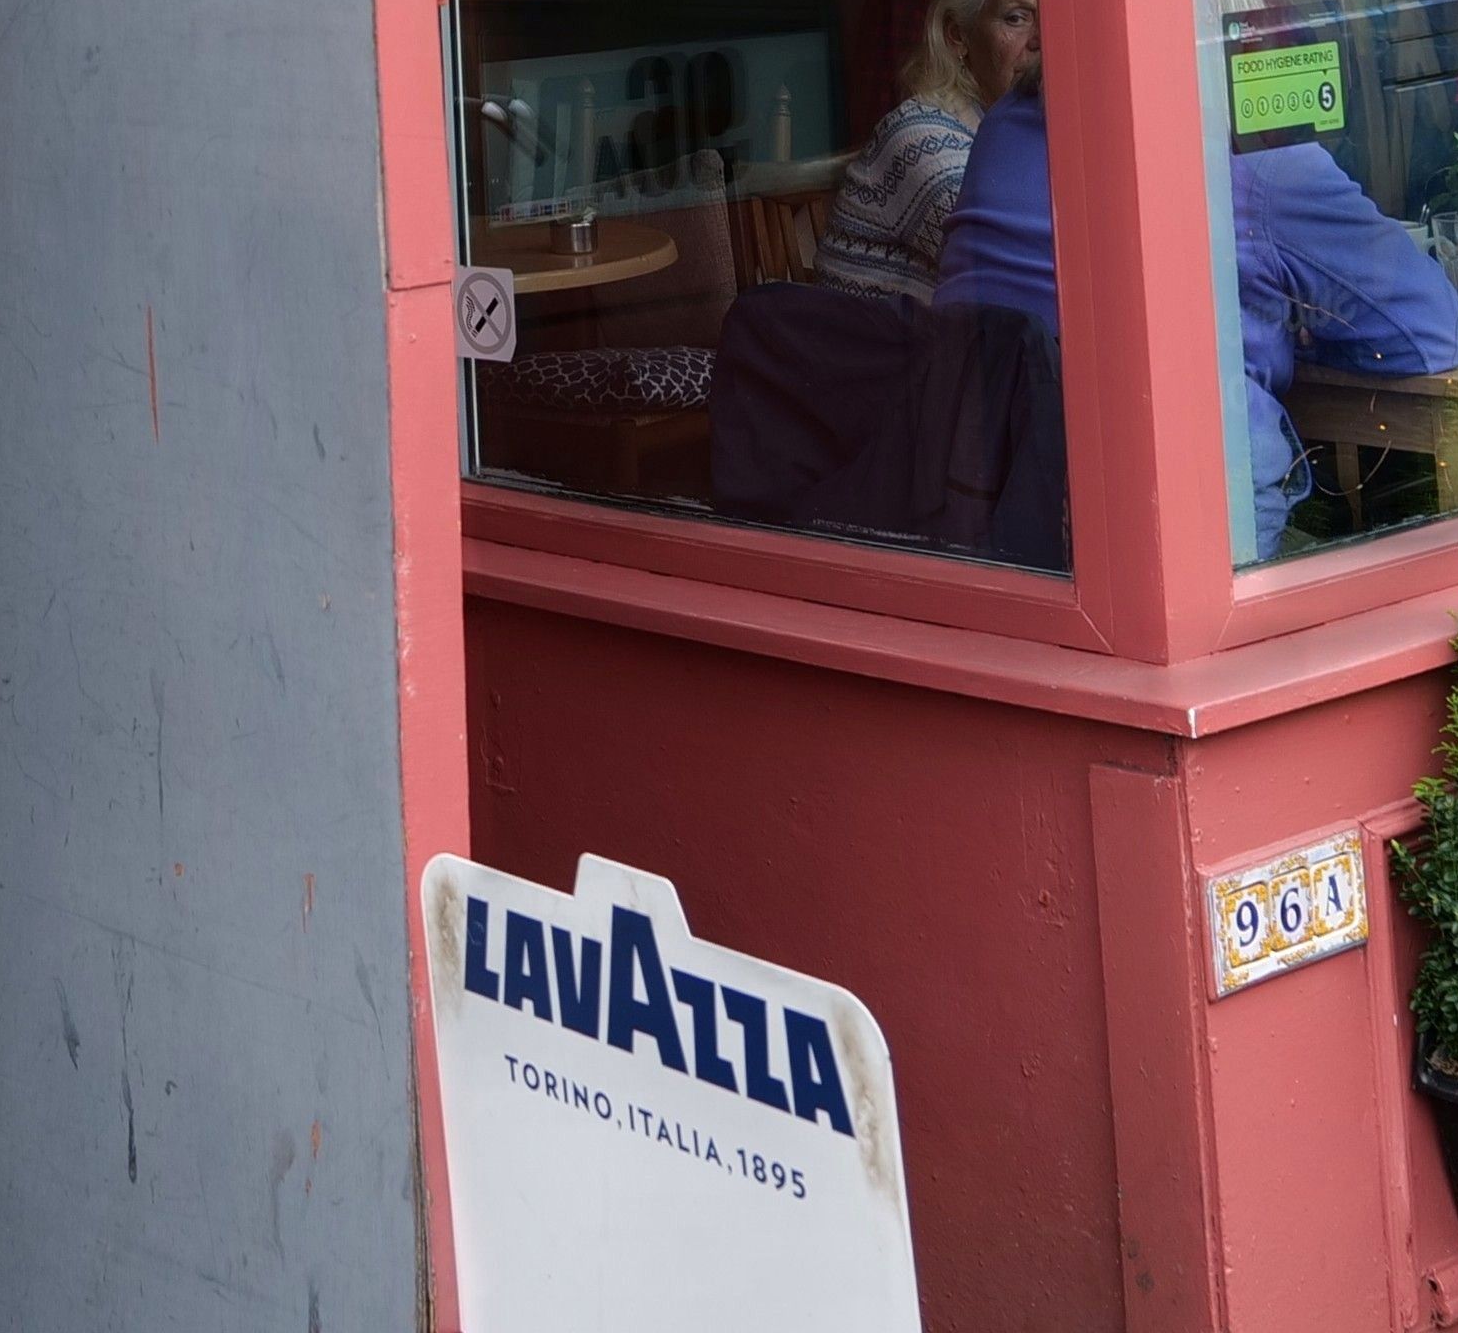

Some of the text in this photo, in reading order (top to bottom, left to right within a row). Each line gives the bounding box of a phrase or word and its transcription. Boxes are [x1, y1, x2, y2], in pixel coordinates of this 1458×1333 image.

[1237, 50, 1333, 75] FOOD HYGIENE RATING
[1236, 874, 1344, 948] 96A
[464, 895, 856, 1139] LAVAZZA
[736, 1148, 807, 1200] 1895
